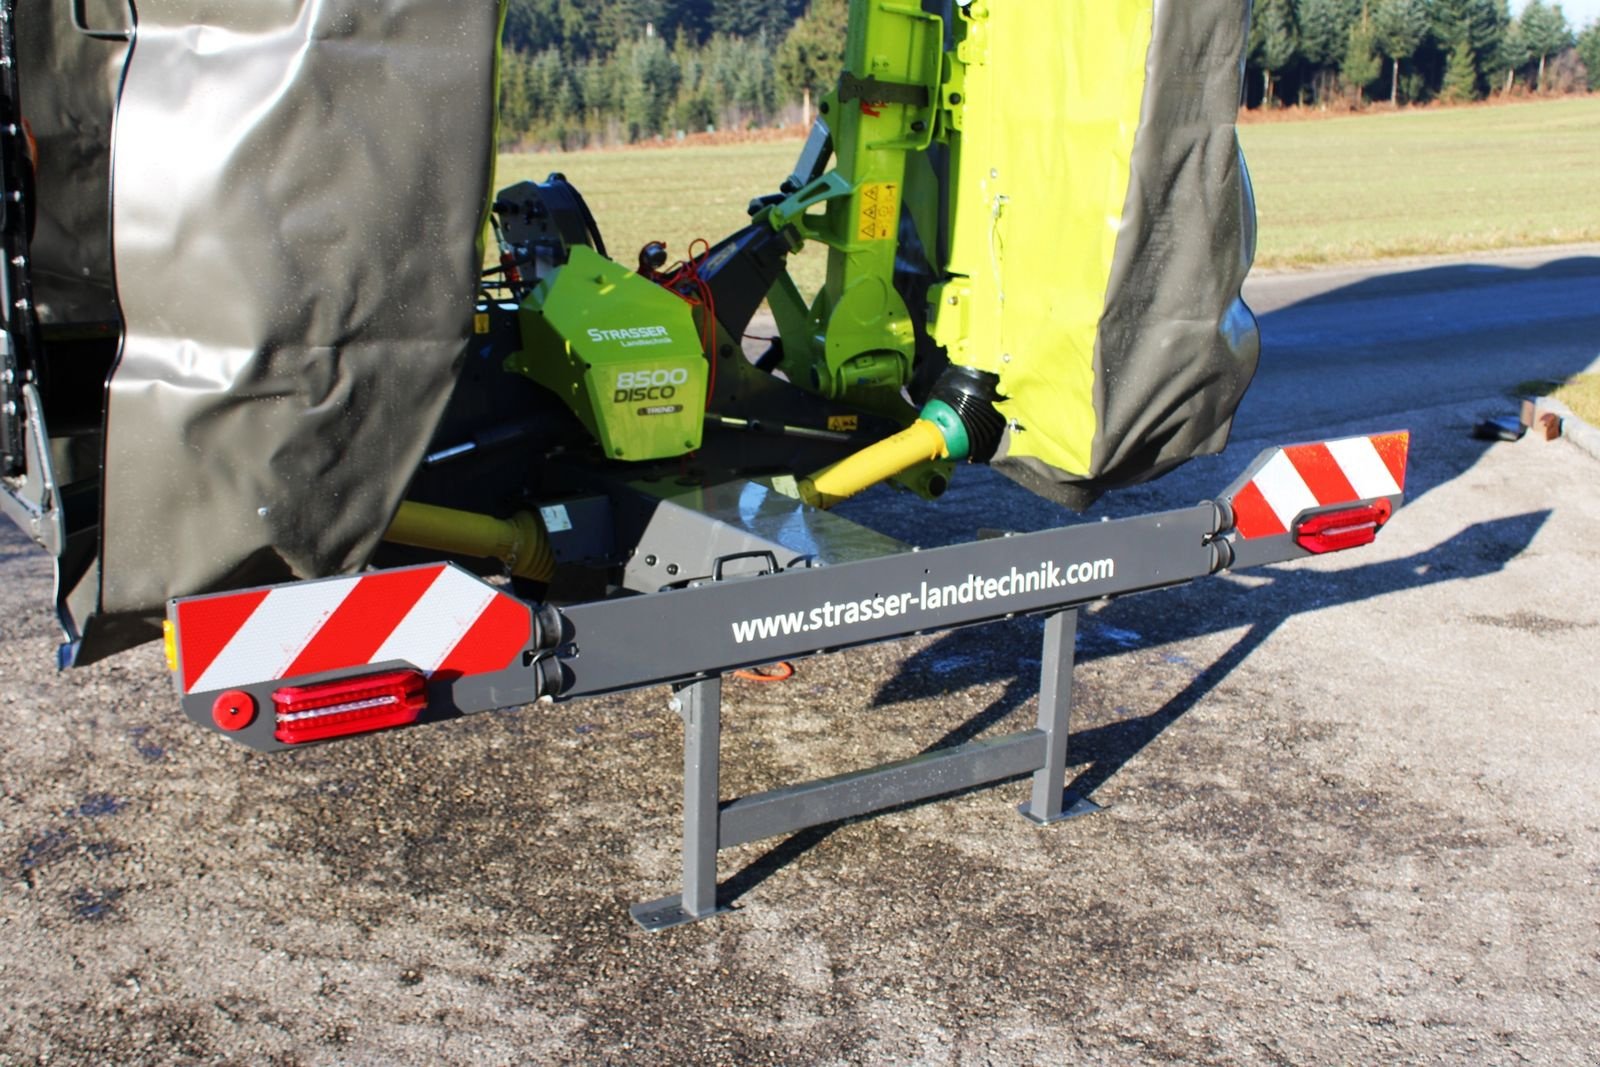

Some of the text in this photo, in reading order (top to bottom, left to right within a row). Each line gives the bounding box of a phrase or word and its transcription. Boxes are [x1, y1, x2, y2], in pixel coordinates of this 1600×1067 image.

[587, 325, 668, 343] STRASSER
[620, 336, 673, 348] Landtechnik
[617, 368, 688, 389] 8500
[613, 385, 676, 404] DISCO
[731, 557, 1115, 644] www.strasser-landtechnik.com
